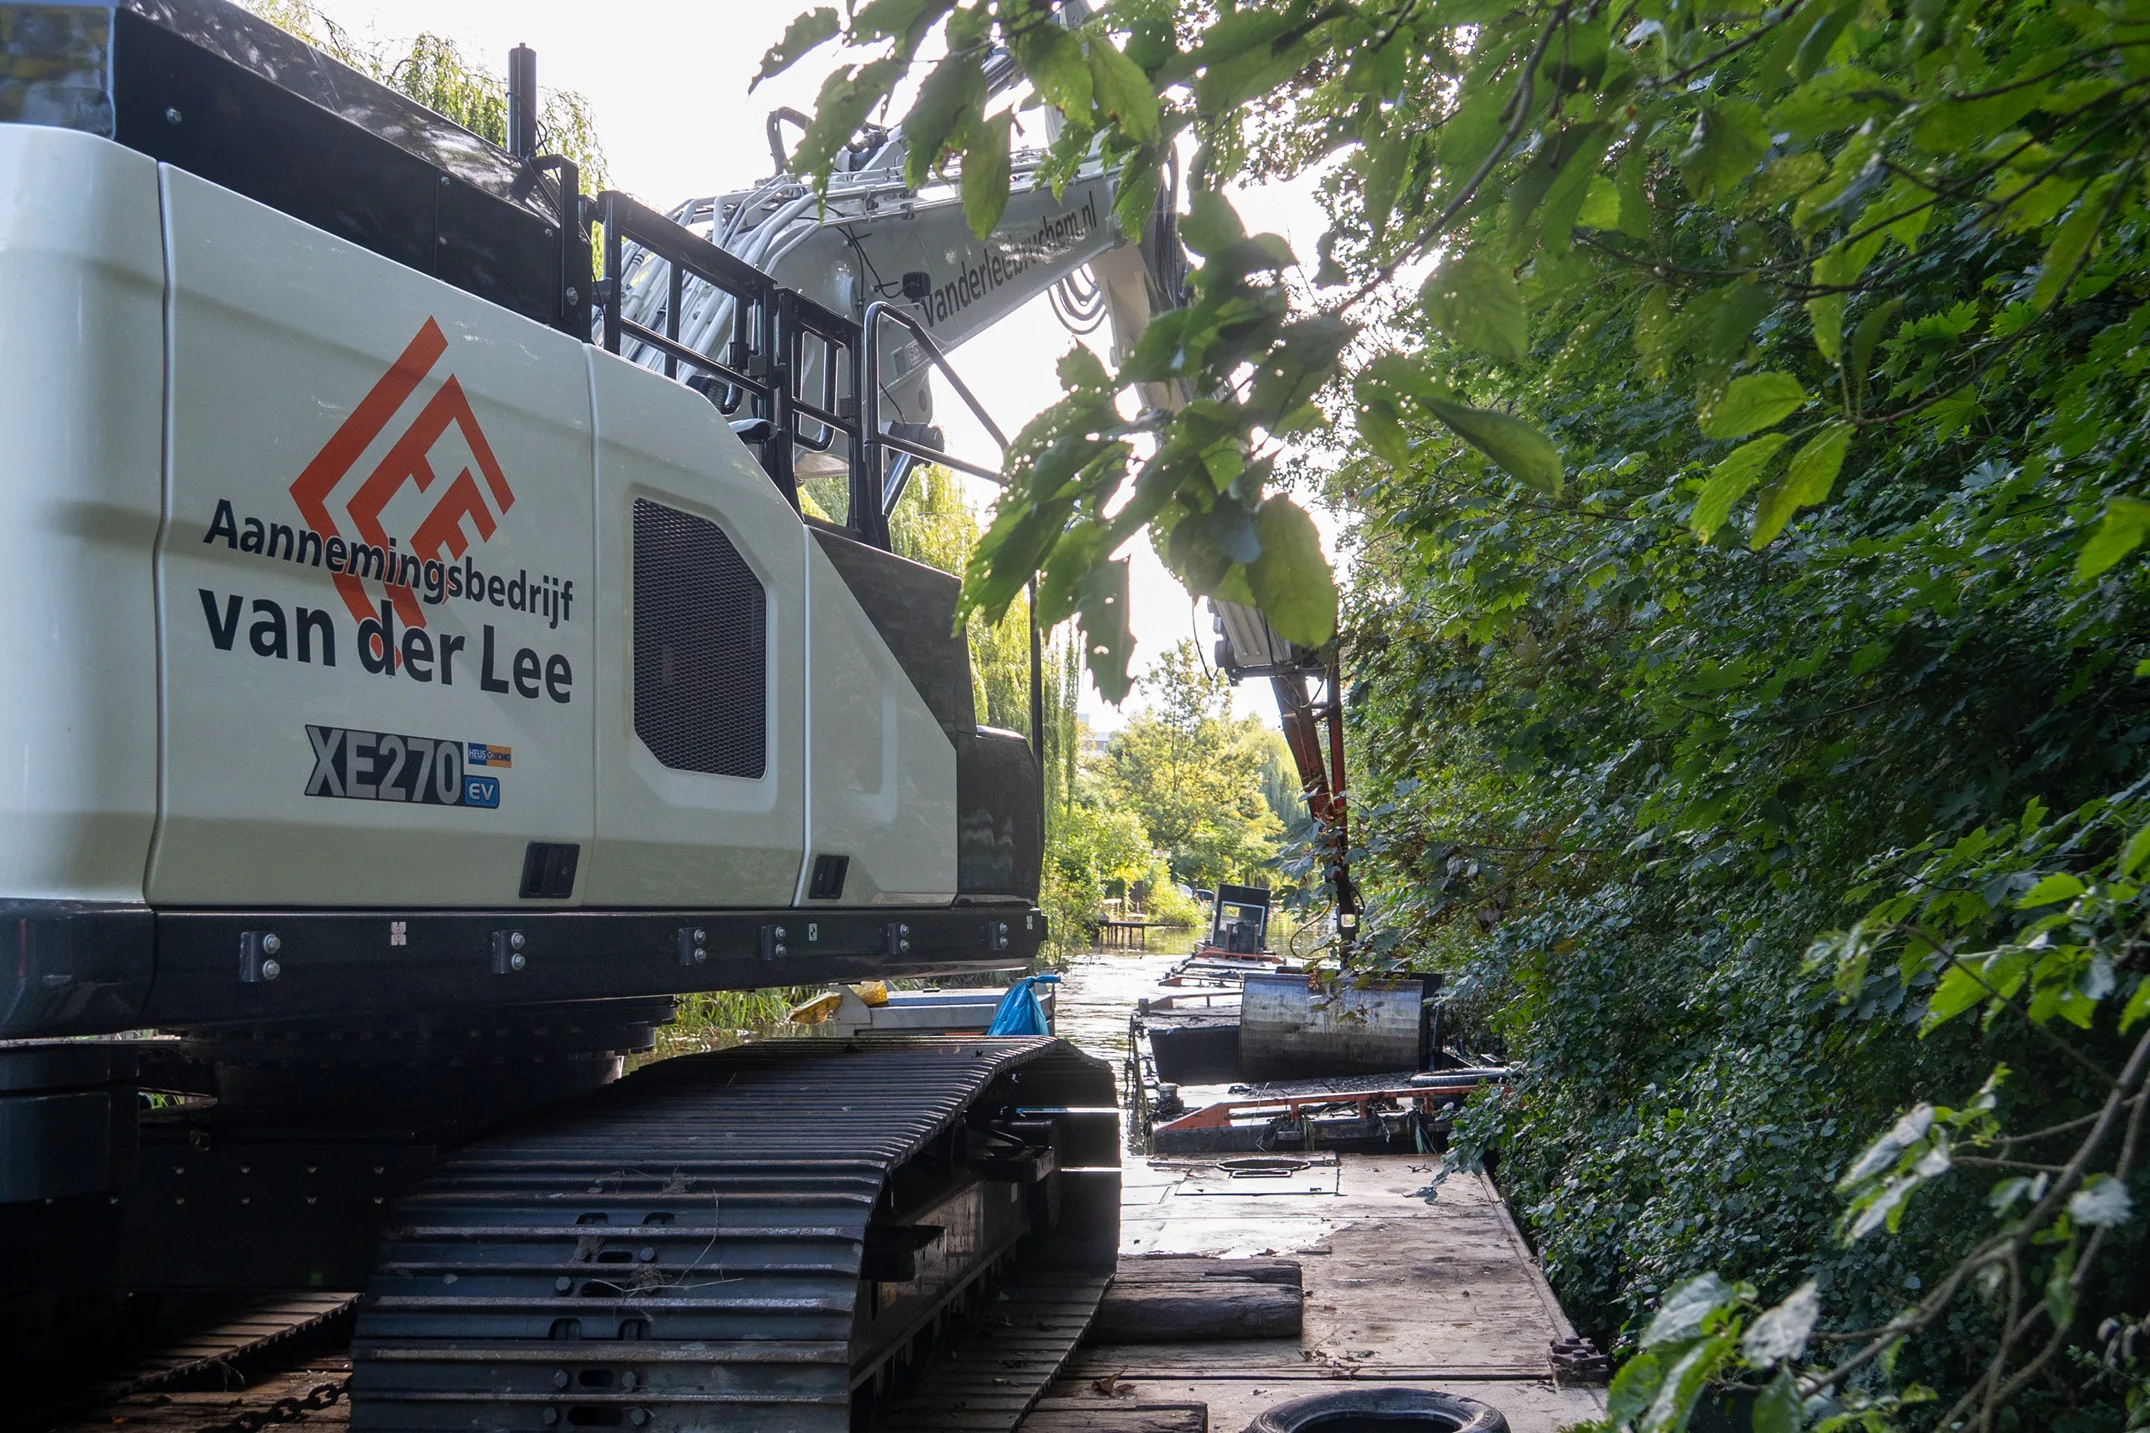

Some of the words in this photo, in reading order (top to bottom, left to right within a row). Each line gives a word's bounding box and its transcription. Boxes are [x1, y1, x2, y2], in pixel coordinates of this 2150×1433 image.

[922, 190, 1097, 328] vanderleebruchem.nl
[203, 498, 573, 629] Aannemingsbedrijf
[198, 588, 336, 667] van
[357, 599, 465, 686] der
[480, 624, 573, 704] Lee
[305, 725, 463, 805] XE270
[468, 782, 494, 801] EV
